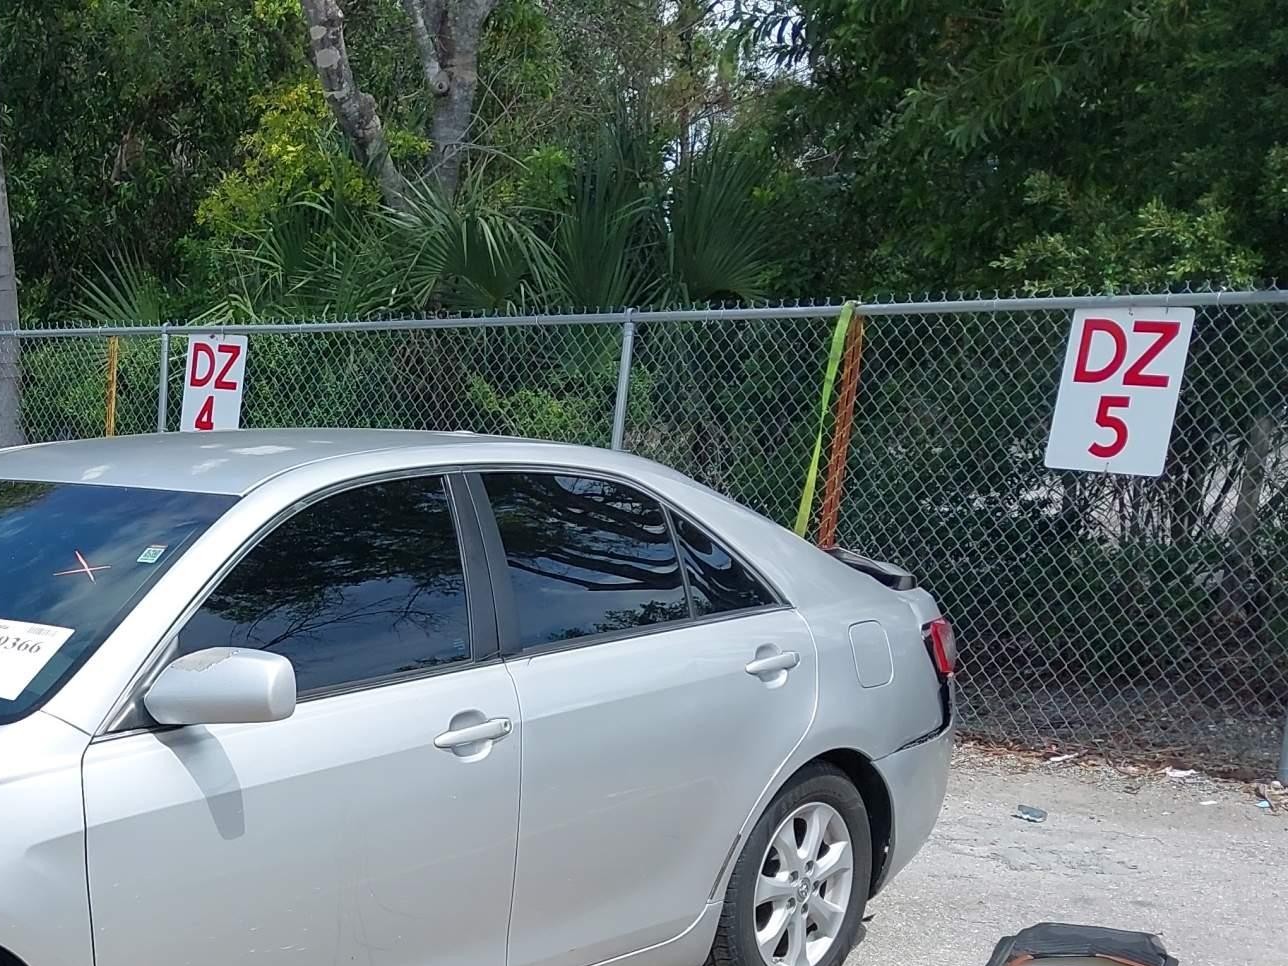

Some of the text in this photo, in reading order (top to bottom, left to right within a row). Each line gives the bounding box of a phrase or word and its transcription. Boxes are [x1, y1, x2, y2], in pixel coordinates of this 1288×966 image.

[190, 342, 240, 390] DZ
[1073, 318, 1181, 388] DZ
[194, 395, 214, 430] 4
[1088, 395, 1130, 458] 5
